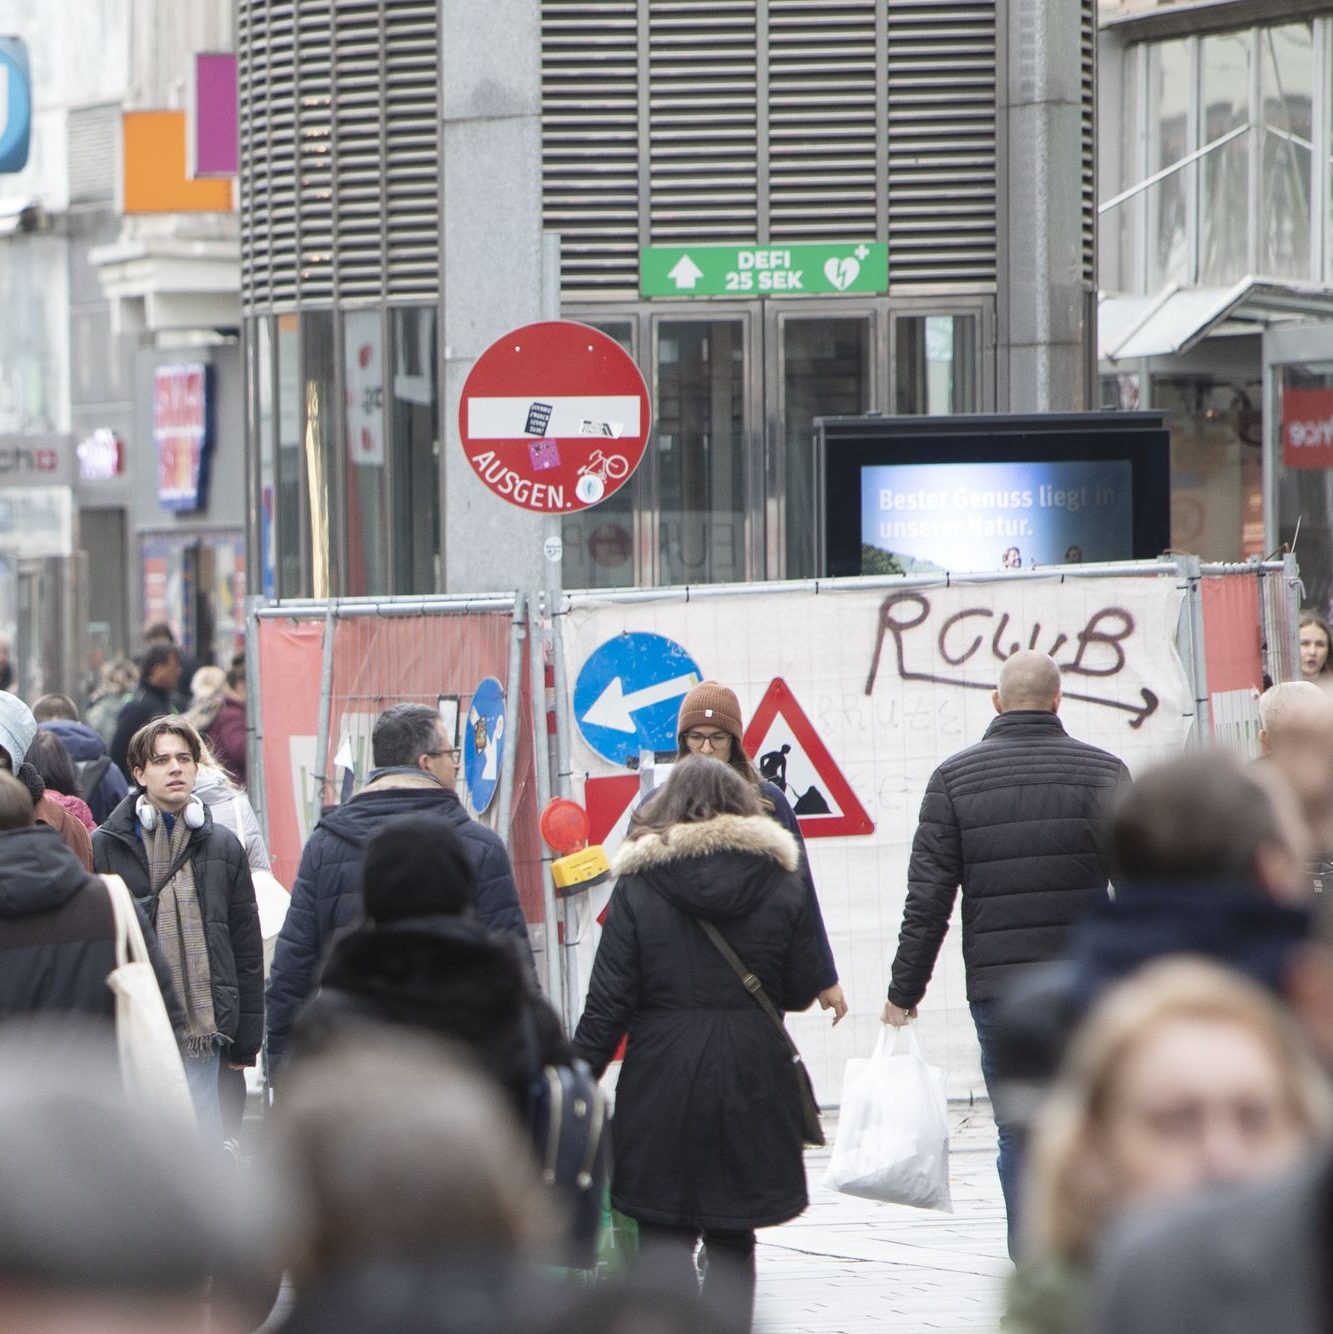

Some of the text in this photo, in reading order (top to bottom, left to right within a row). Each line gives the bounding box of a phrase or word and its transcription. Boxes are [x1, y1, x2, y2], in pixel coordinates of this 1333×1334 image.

[737, 251, 791, 270] DEFI
[725, 270, 804, 291] 25 SEK
[472, 451, 572, 508] AUSGEN.
[879, 489, 947, 511] Bester
[953, 486, 1033, 510] Genuss
[1039, 485, 1087, 511] liegt
[968, 516, 1033, 537] Natur.
